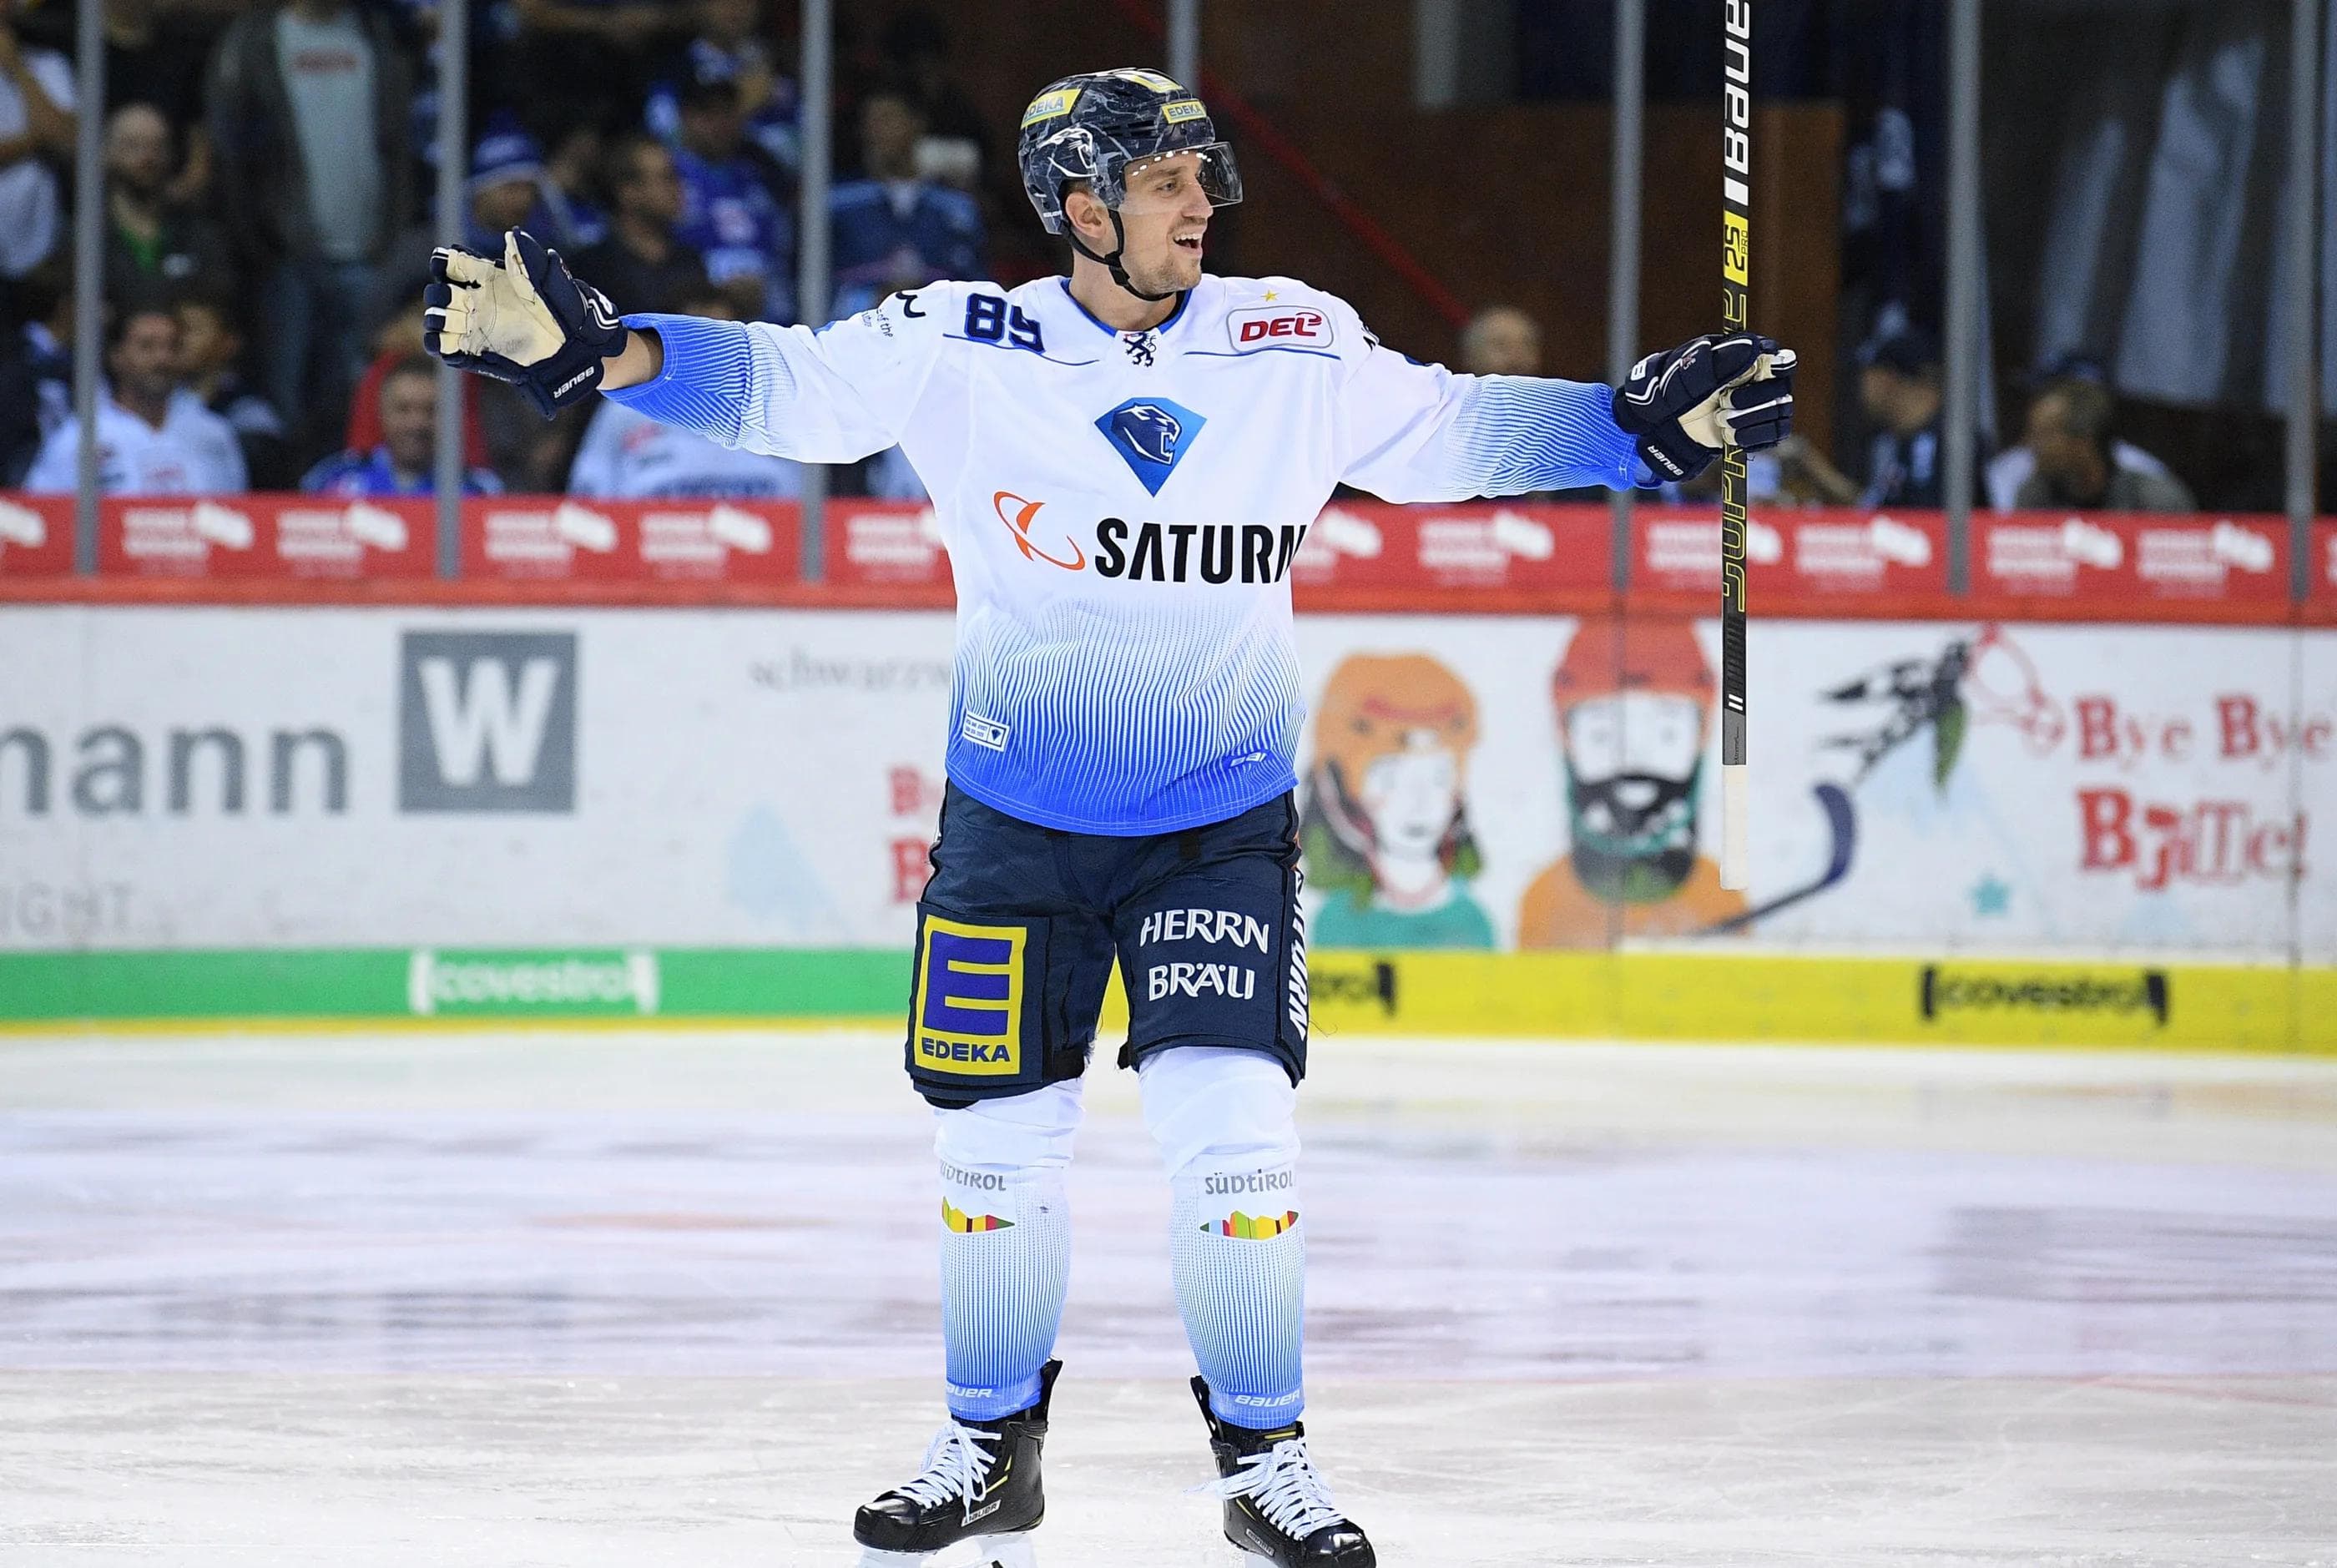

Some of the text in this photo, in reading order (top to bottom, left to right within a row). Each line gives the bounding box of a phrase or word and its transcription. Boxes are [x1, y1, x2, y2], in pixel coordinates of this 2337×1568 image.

[1167, 103, 1203, 117] EDEKA
[1094, 517, 1307, 584] SATURN
[419, 657, 560, 788] W
[1139, 908, 1270, 955] HERRN
[1148, 962, 1256, 1002] BRÄU
[921, 1036, 1012, 1063] EDEKA
[946, 1384, 993, 1398] AUER
